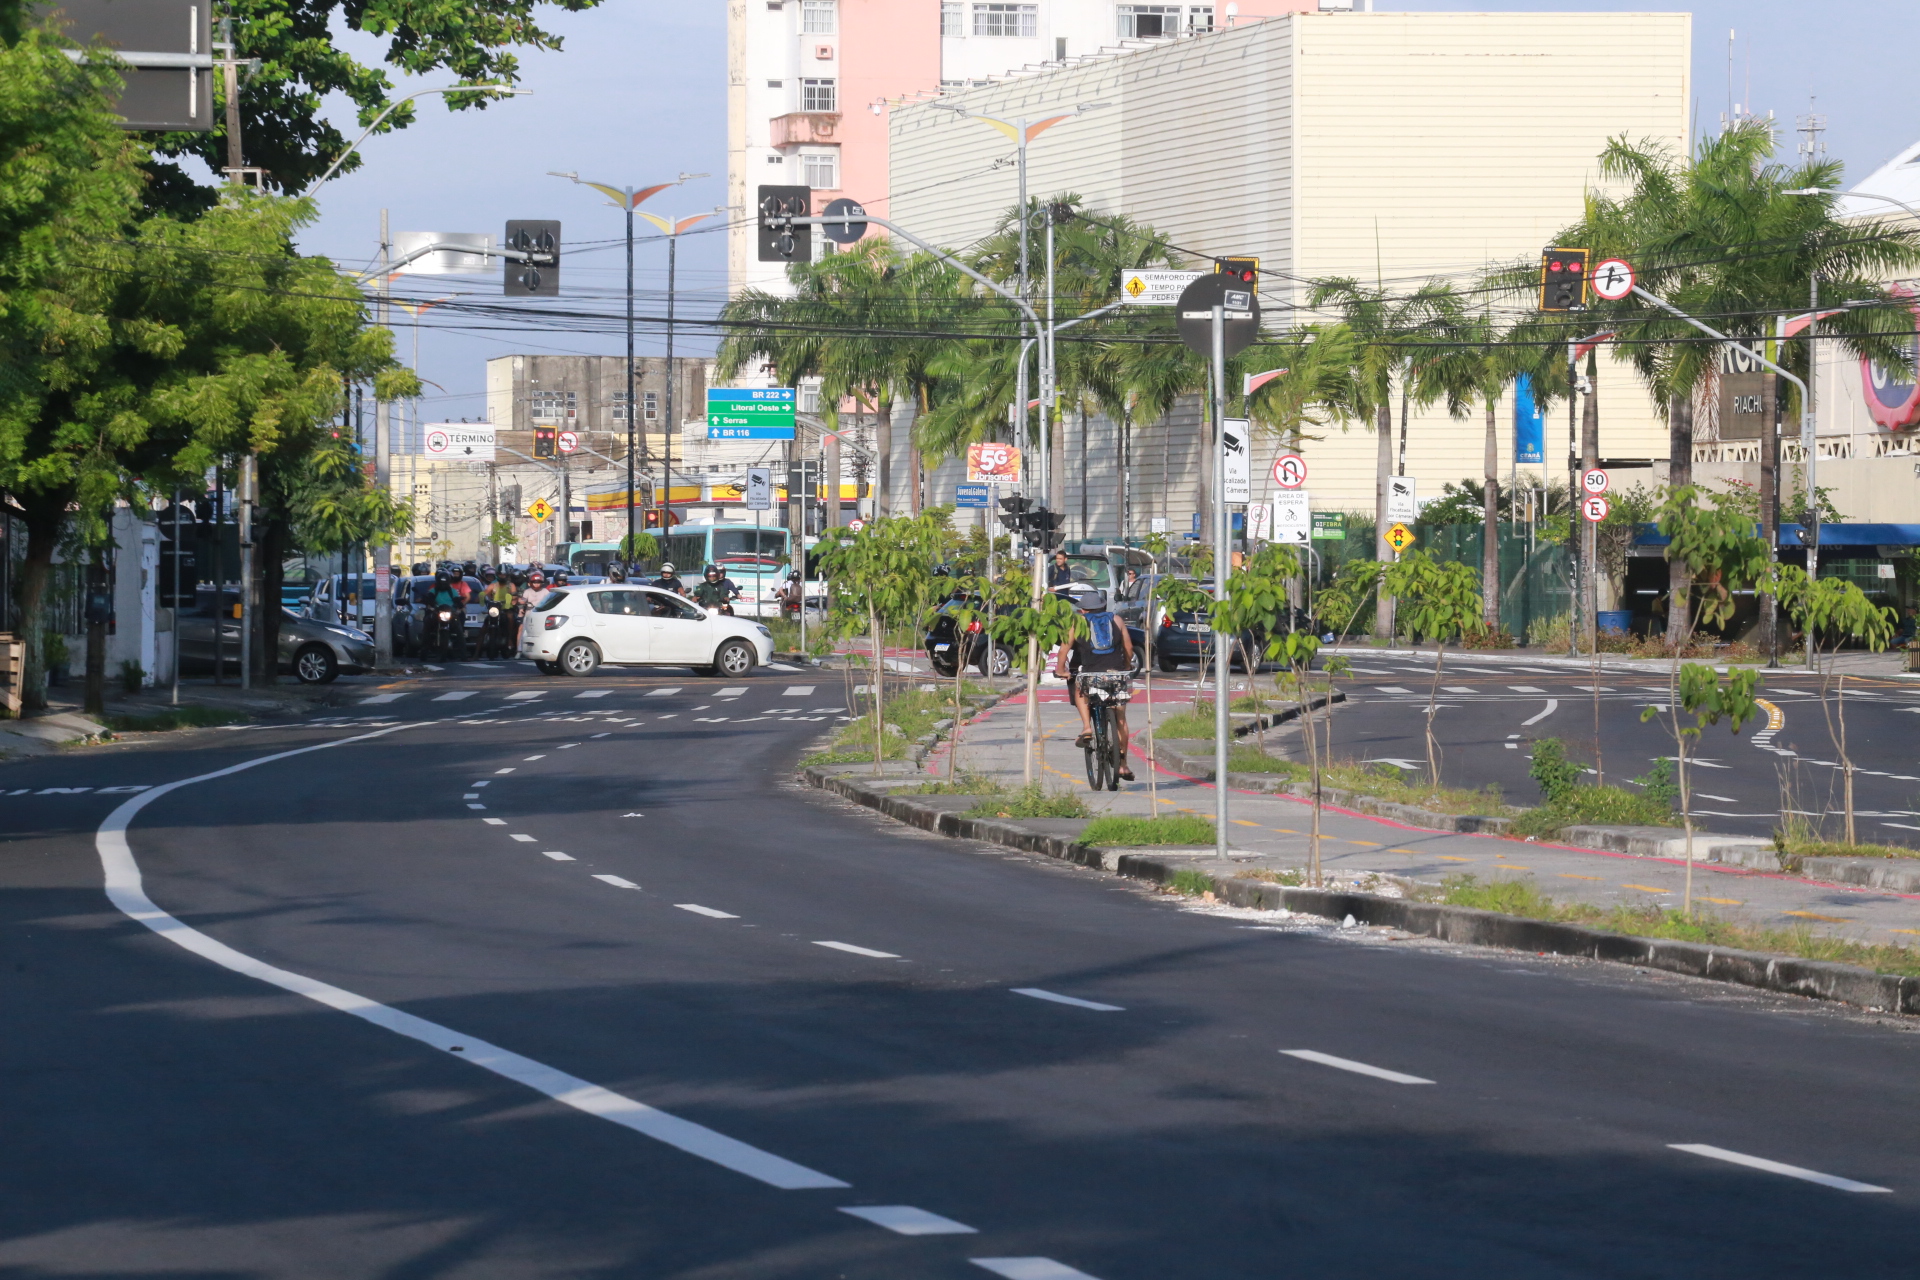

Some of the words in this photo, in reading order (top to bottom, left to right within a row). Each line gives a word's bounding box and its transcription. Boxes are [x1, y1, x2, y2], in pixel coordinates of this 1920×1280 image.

[1144, 272, 1185, 281] SEMÁFORO
[752, 391, 764, 399] BR
[765, 391, 780, 399] 222
[757, 404, 780, 412] Oeste
[722, 416, 748, 424] Serras
[722, 429, 735, 437] BR
[736, 429, 750, 437] 116
[449, 433, 495, 443] TÉRMINO
[980, 450, 1008, 471] 5G
[980, 472, 1013, 481] brisanet
[1587, 475, 1604, 485] 50
[1591, 502, 1600, 515] E
